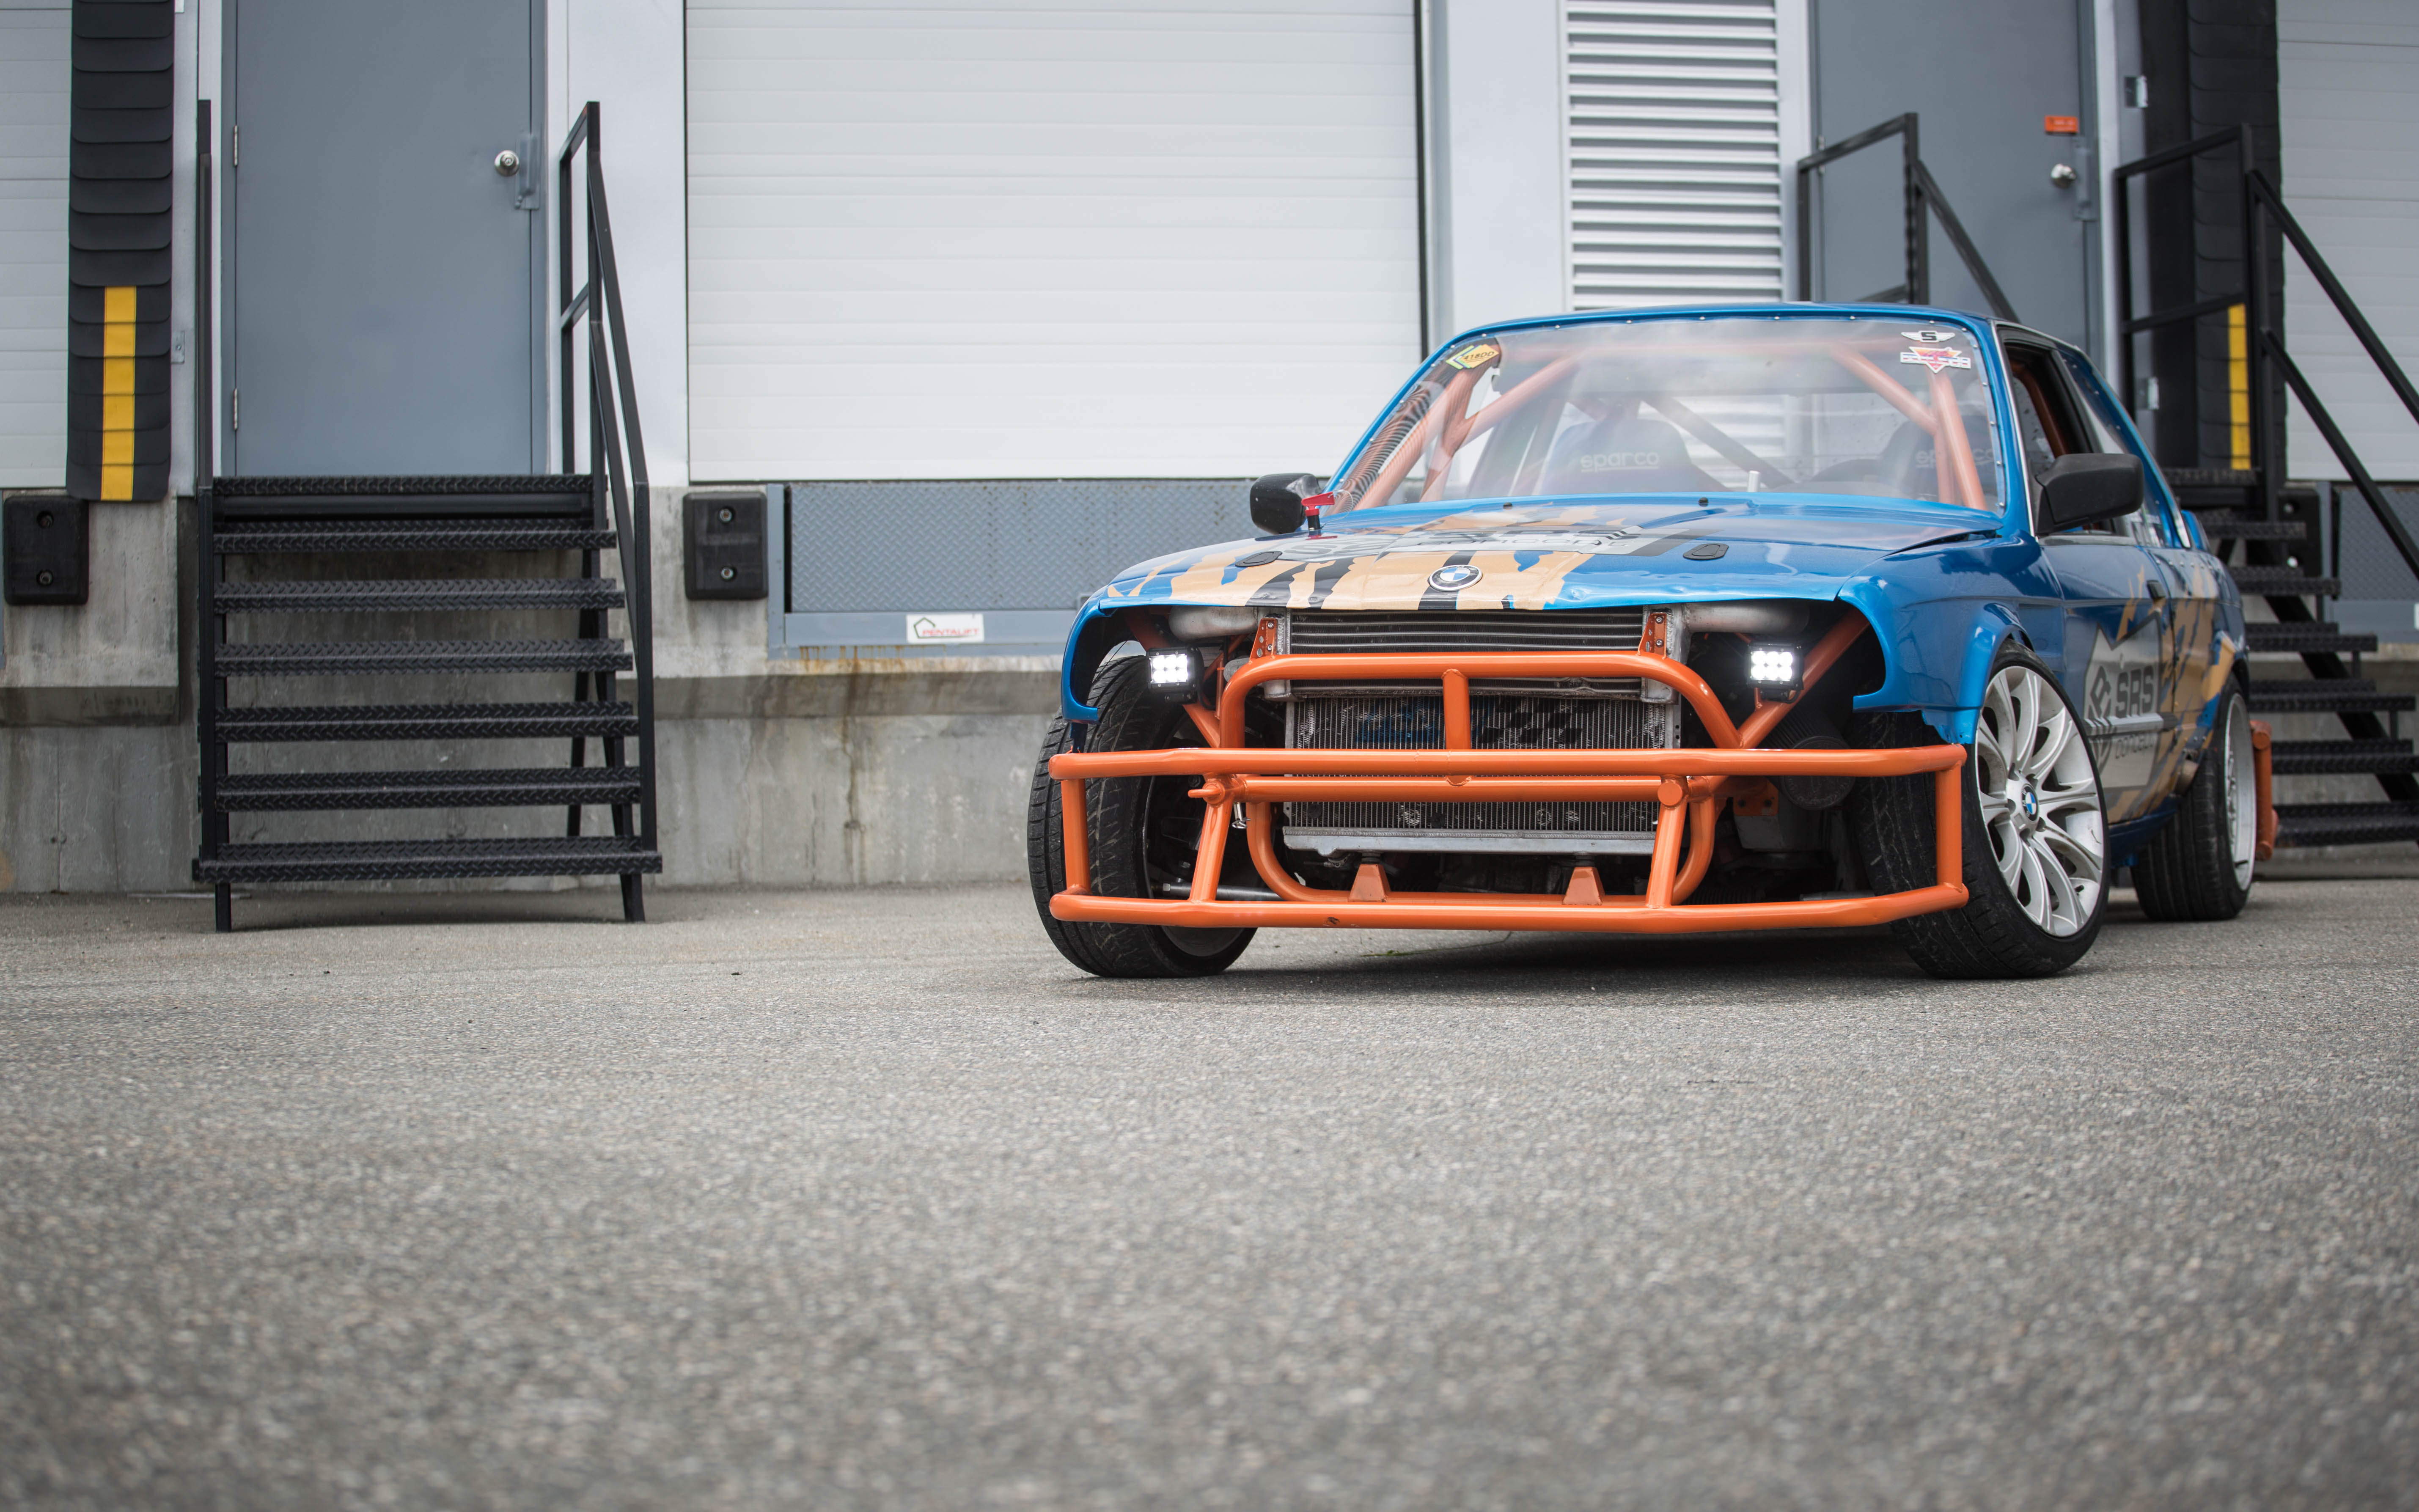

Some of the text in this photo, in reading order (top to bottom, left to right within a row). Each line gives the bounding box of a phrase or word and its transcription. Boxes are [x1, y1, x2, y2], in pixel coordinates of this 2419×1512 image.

[1580, 452, 1660, 473] sparco
[1915, 448, 1994, 468] spco
[922, 628, 979, 636] PENTALIFT
[2116, 665, 2154, 719] SRS
